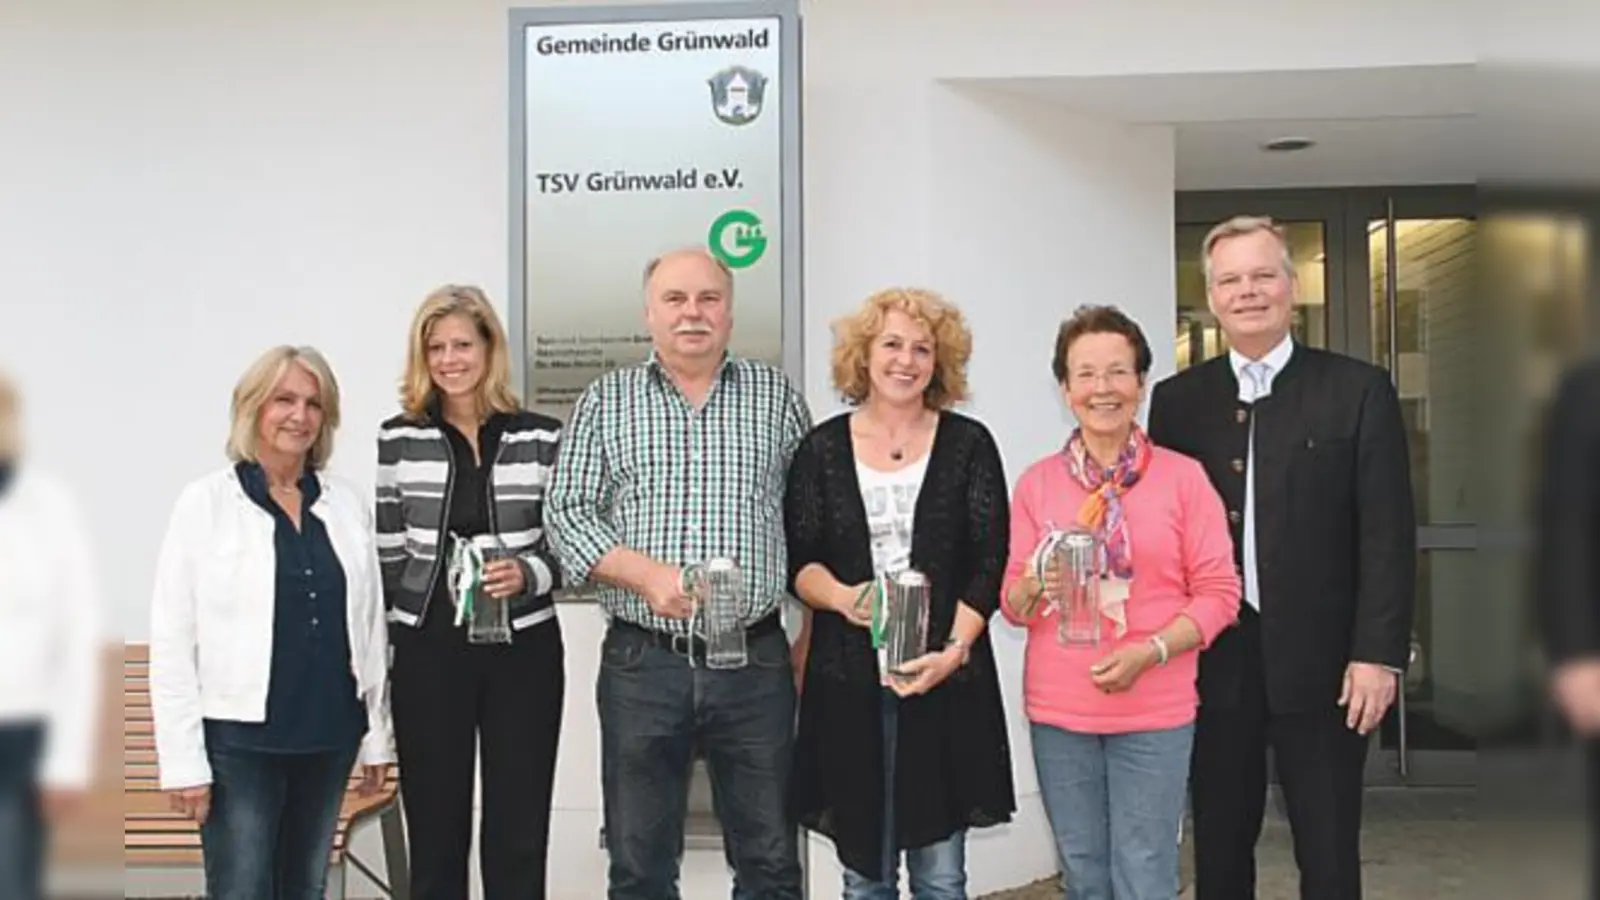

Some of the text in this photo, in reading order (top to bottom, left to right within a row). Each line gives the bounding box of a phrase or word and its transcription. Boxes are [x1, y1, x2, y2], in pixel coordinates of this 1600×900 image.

[537, 28, 769, 55] Gemeinde Grünwald
[536, 168, 743, 193] TSV Grünwald e.V.
